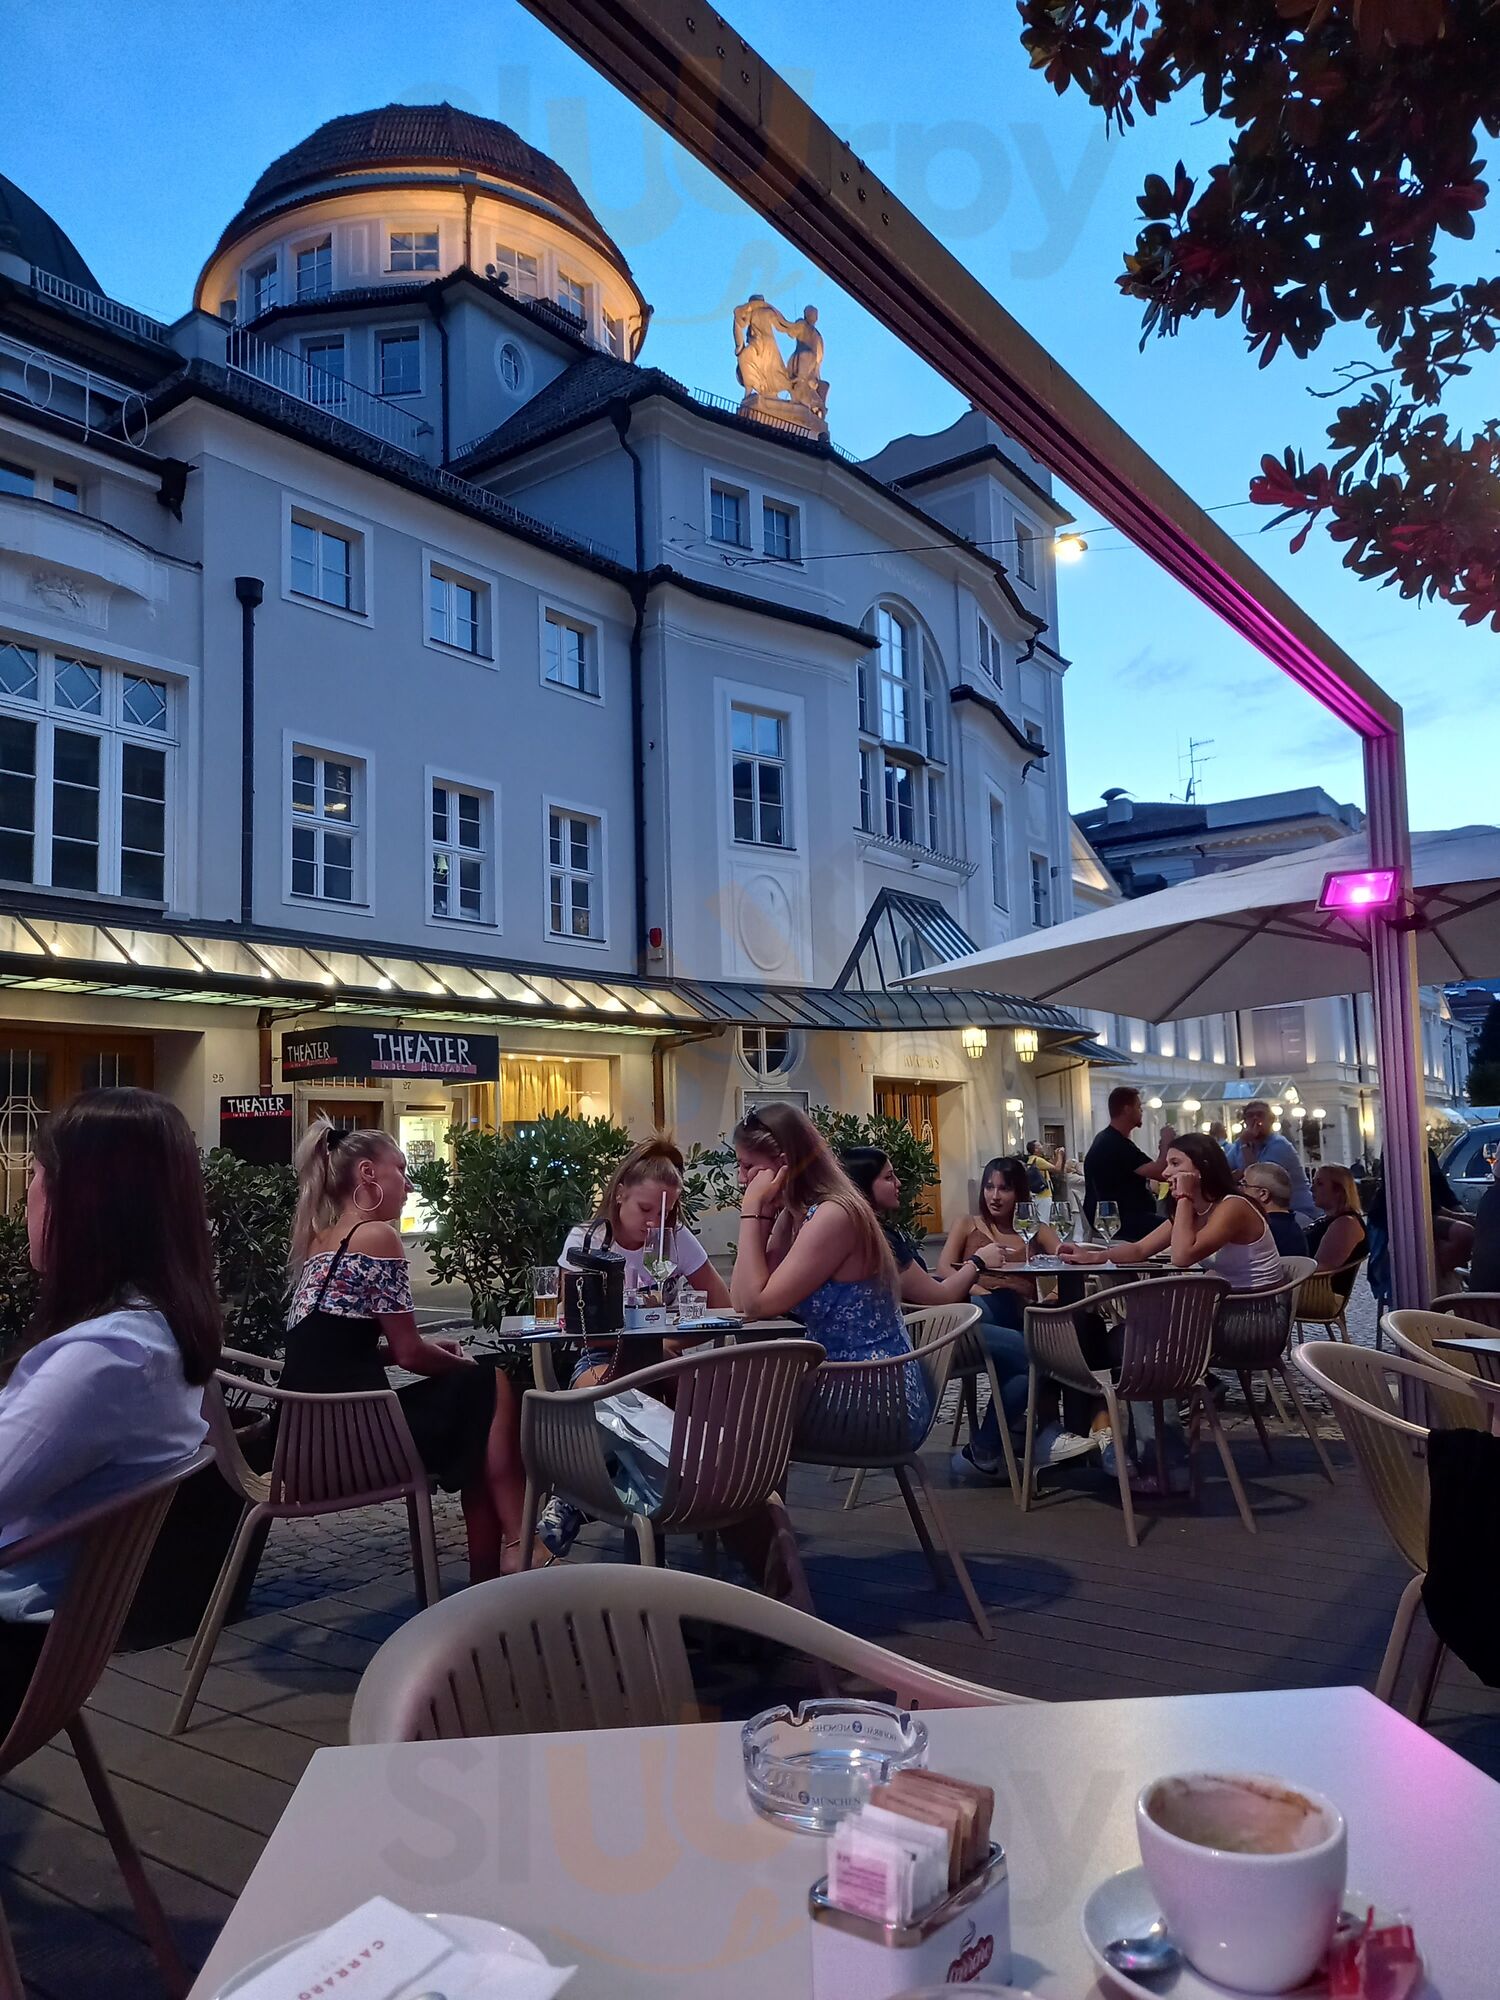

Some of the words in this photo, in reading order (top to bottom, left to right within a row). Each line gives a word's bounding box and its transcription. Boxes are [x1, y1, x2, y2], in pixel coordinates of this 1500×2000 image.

[287, 1042, 330, 1062] THEATER
[373, 1033, 472, 1065] THEATER
[420, 1058, 469, 1073] ALTSTADT
[212, 1073, 225, 1083] 25
[402, 1081, 412, 1090] 27
[228, 1097, 285, 1113] THEATER
[298, 1940, 384, 2000] CARRARO
